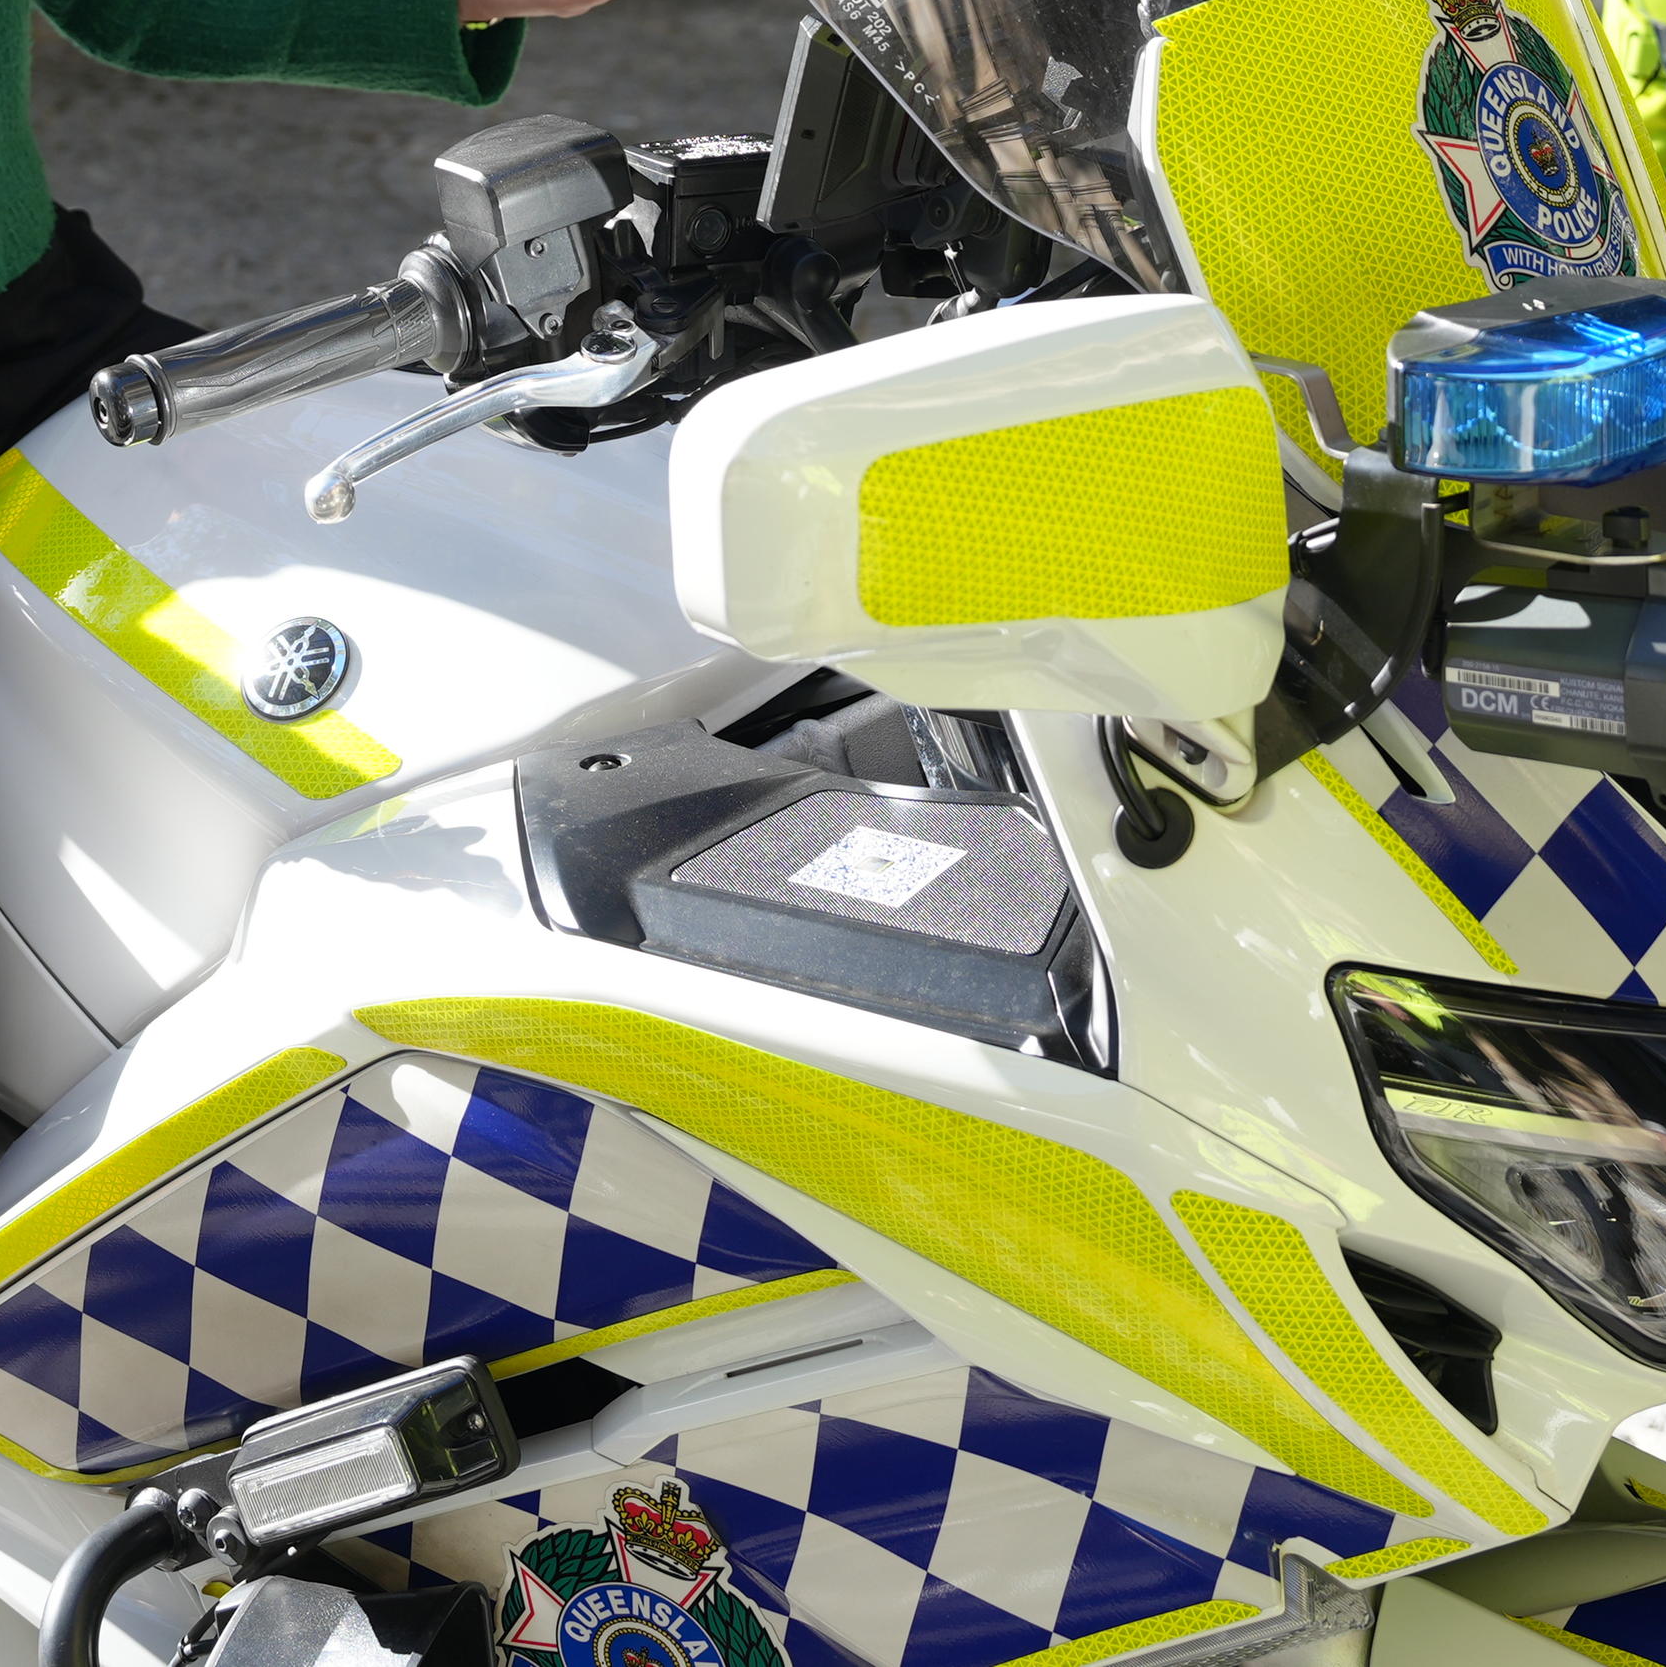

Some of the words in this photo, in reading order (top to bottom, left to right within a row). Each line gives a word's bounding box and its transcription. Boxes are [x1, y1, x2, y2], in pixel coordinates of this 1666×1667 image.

[866, 11, 893, 36] 202
[862, 24, 891, 52] M45
[1481, 69, 1581, 178] QUEENSLAND
[1537, 187, 1598, 241] POLICE
[1502, 246, 1545, 274] WITH
[1460, 687, 1519, 715] DCM
[563, 1588, 719, 1667] QUEENSLA
